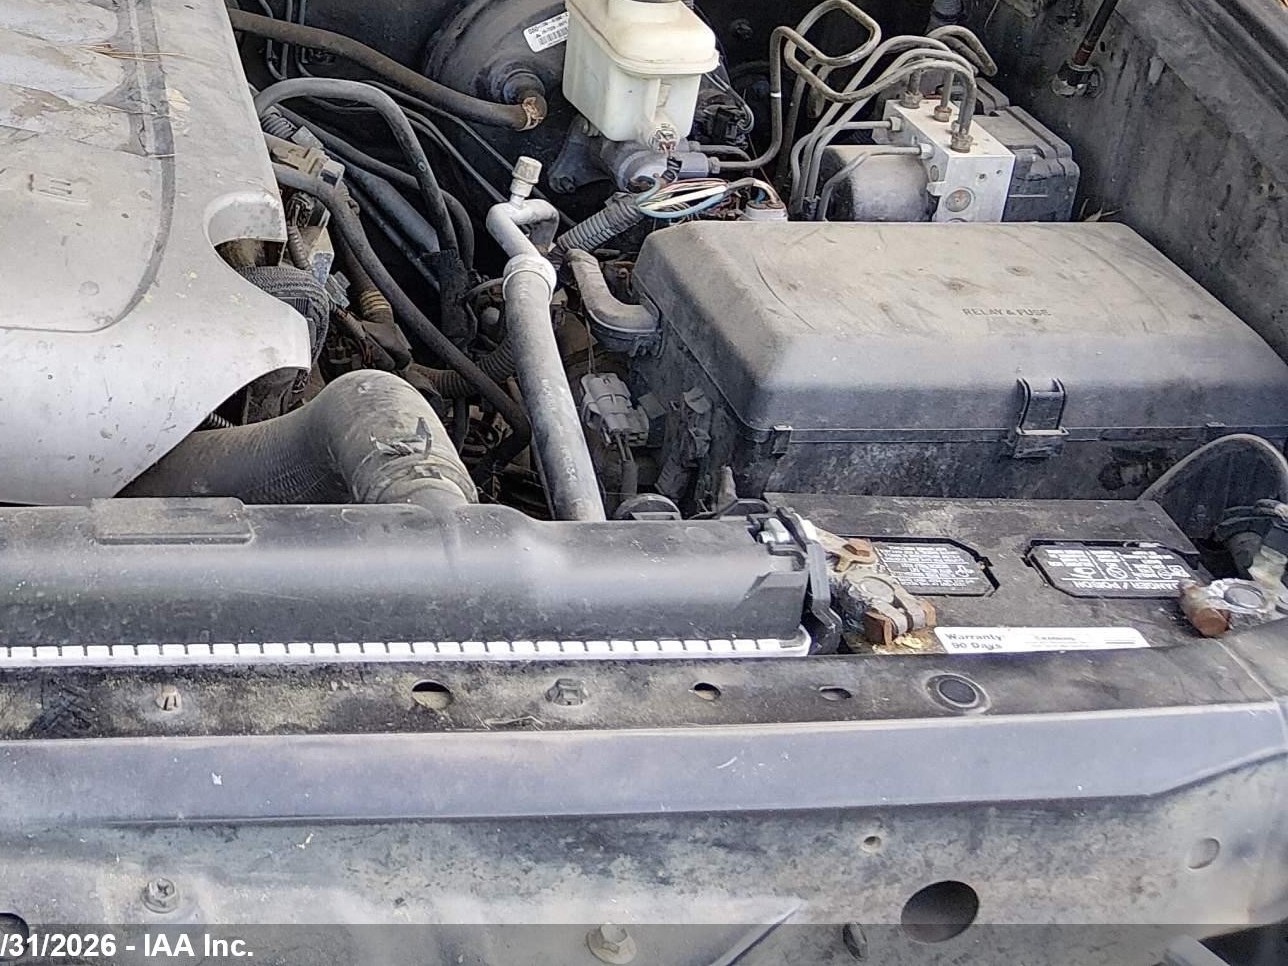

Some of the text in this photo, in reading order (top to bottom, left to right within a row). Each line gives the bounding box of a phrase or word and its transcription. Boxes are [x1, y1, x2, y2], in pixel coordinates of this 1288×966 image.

[961, 308, 1051, 317] RELAY & FUSE
